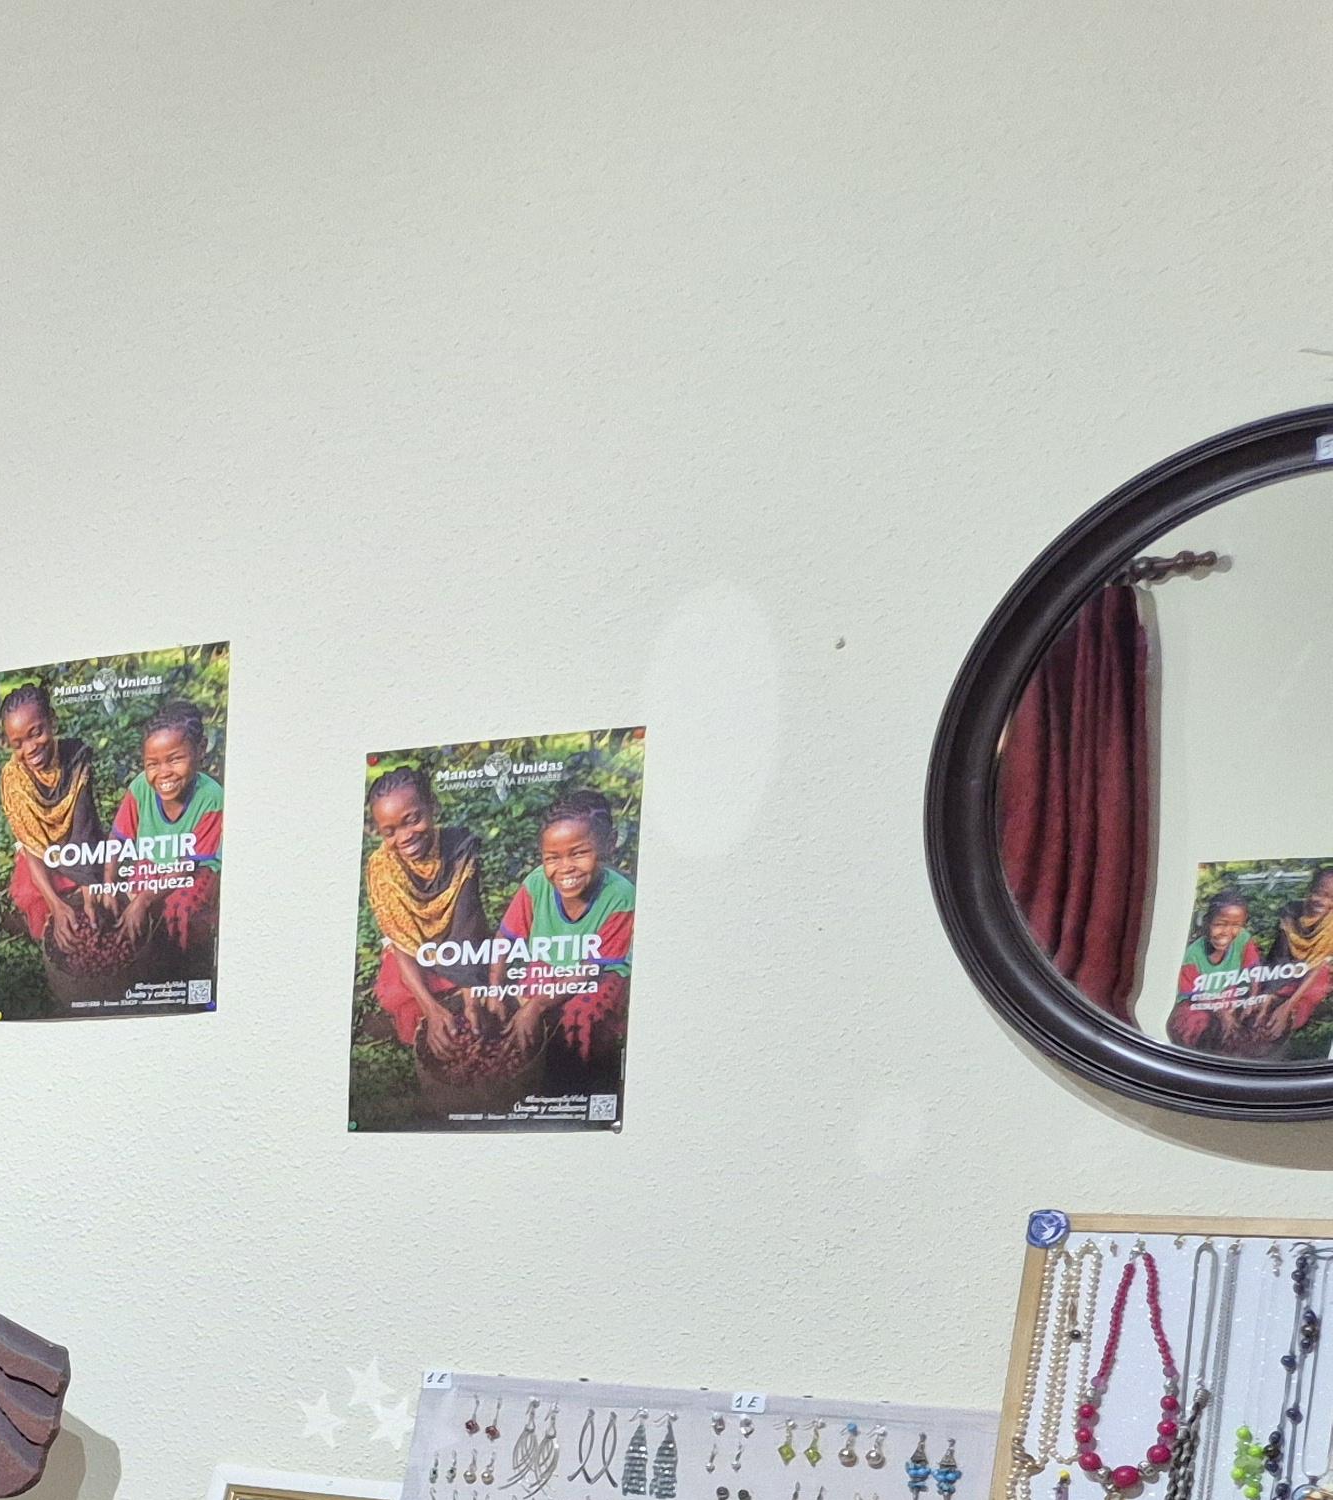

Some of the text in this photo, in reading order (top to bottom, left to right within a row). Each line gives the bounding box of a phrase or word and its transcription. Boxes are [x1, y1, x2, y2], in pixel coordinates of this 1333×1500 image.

[53, 675, 163, 697] Manos Unidas
[435, 760, 563, 781] Manos Unidas
[43, 833, 197, 868] COMPARTIR
[118, 859, 195, 877] es nuestra
[89, 876, 194, 897] mayor riqueza
[416, 934, 602, 967] COMPARTIR
[507, 962, 600, 980] es nuestra
[470, 979, 598, 1001] mayor riqueza
